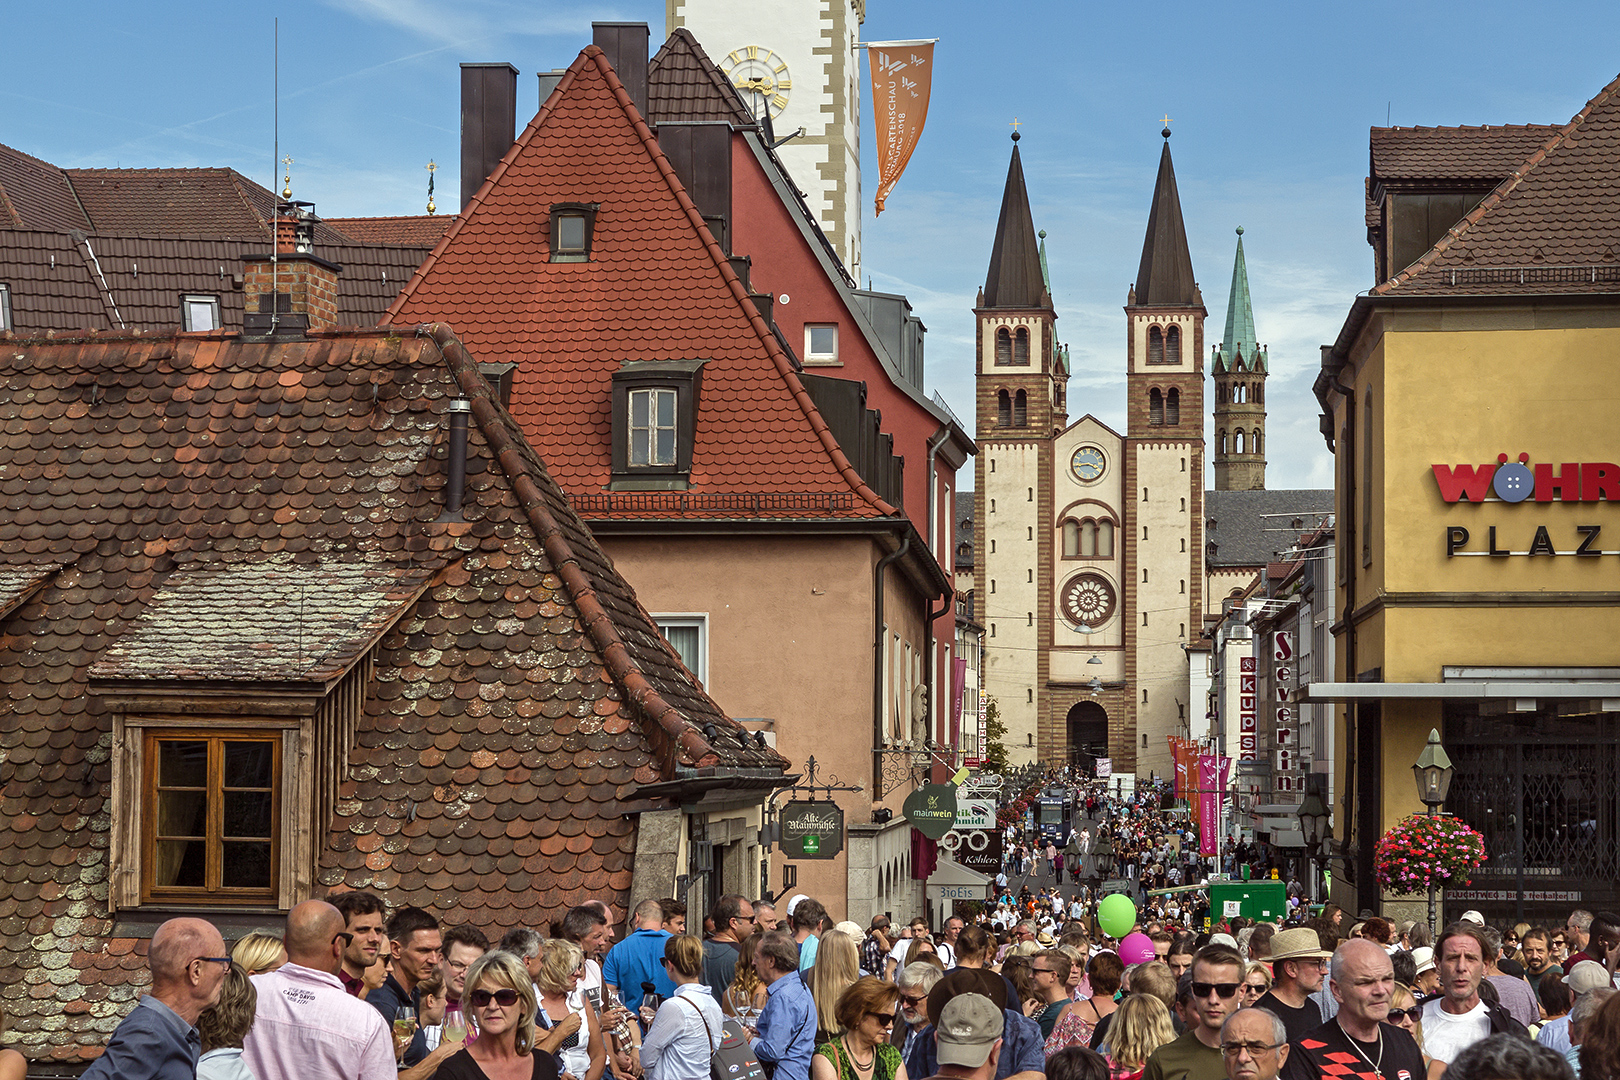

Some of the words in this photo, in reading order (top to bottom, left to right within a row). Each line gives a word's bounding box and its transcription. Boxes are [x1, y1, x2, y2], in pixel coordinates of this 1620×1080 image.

[898, 112, 906, 134] 2018
[1447, 525, 1620, 558] PLAZ
[1275, 632, 1292, 791] Severin
[803, 813, 819, 822] Alte
[913, 808, 952, 818] mainwein
[787, 820, 835, 831] Mainmühle
[964, 854, 998, 864] Köhlers
